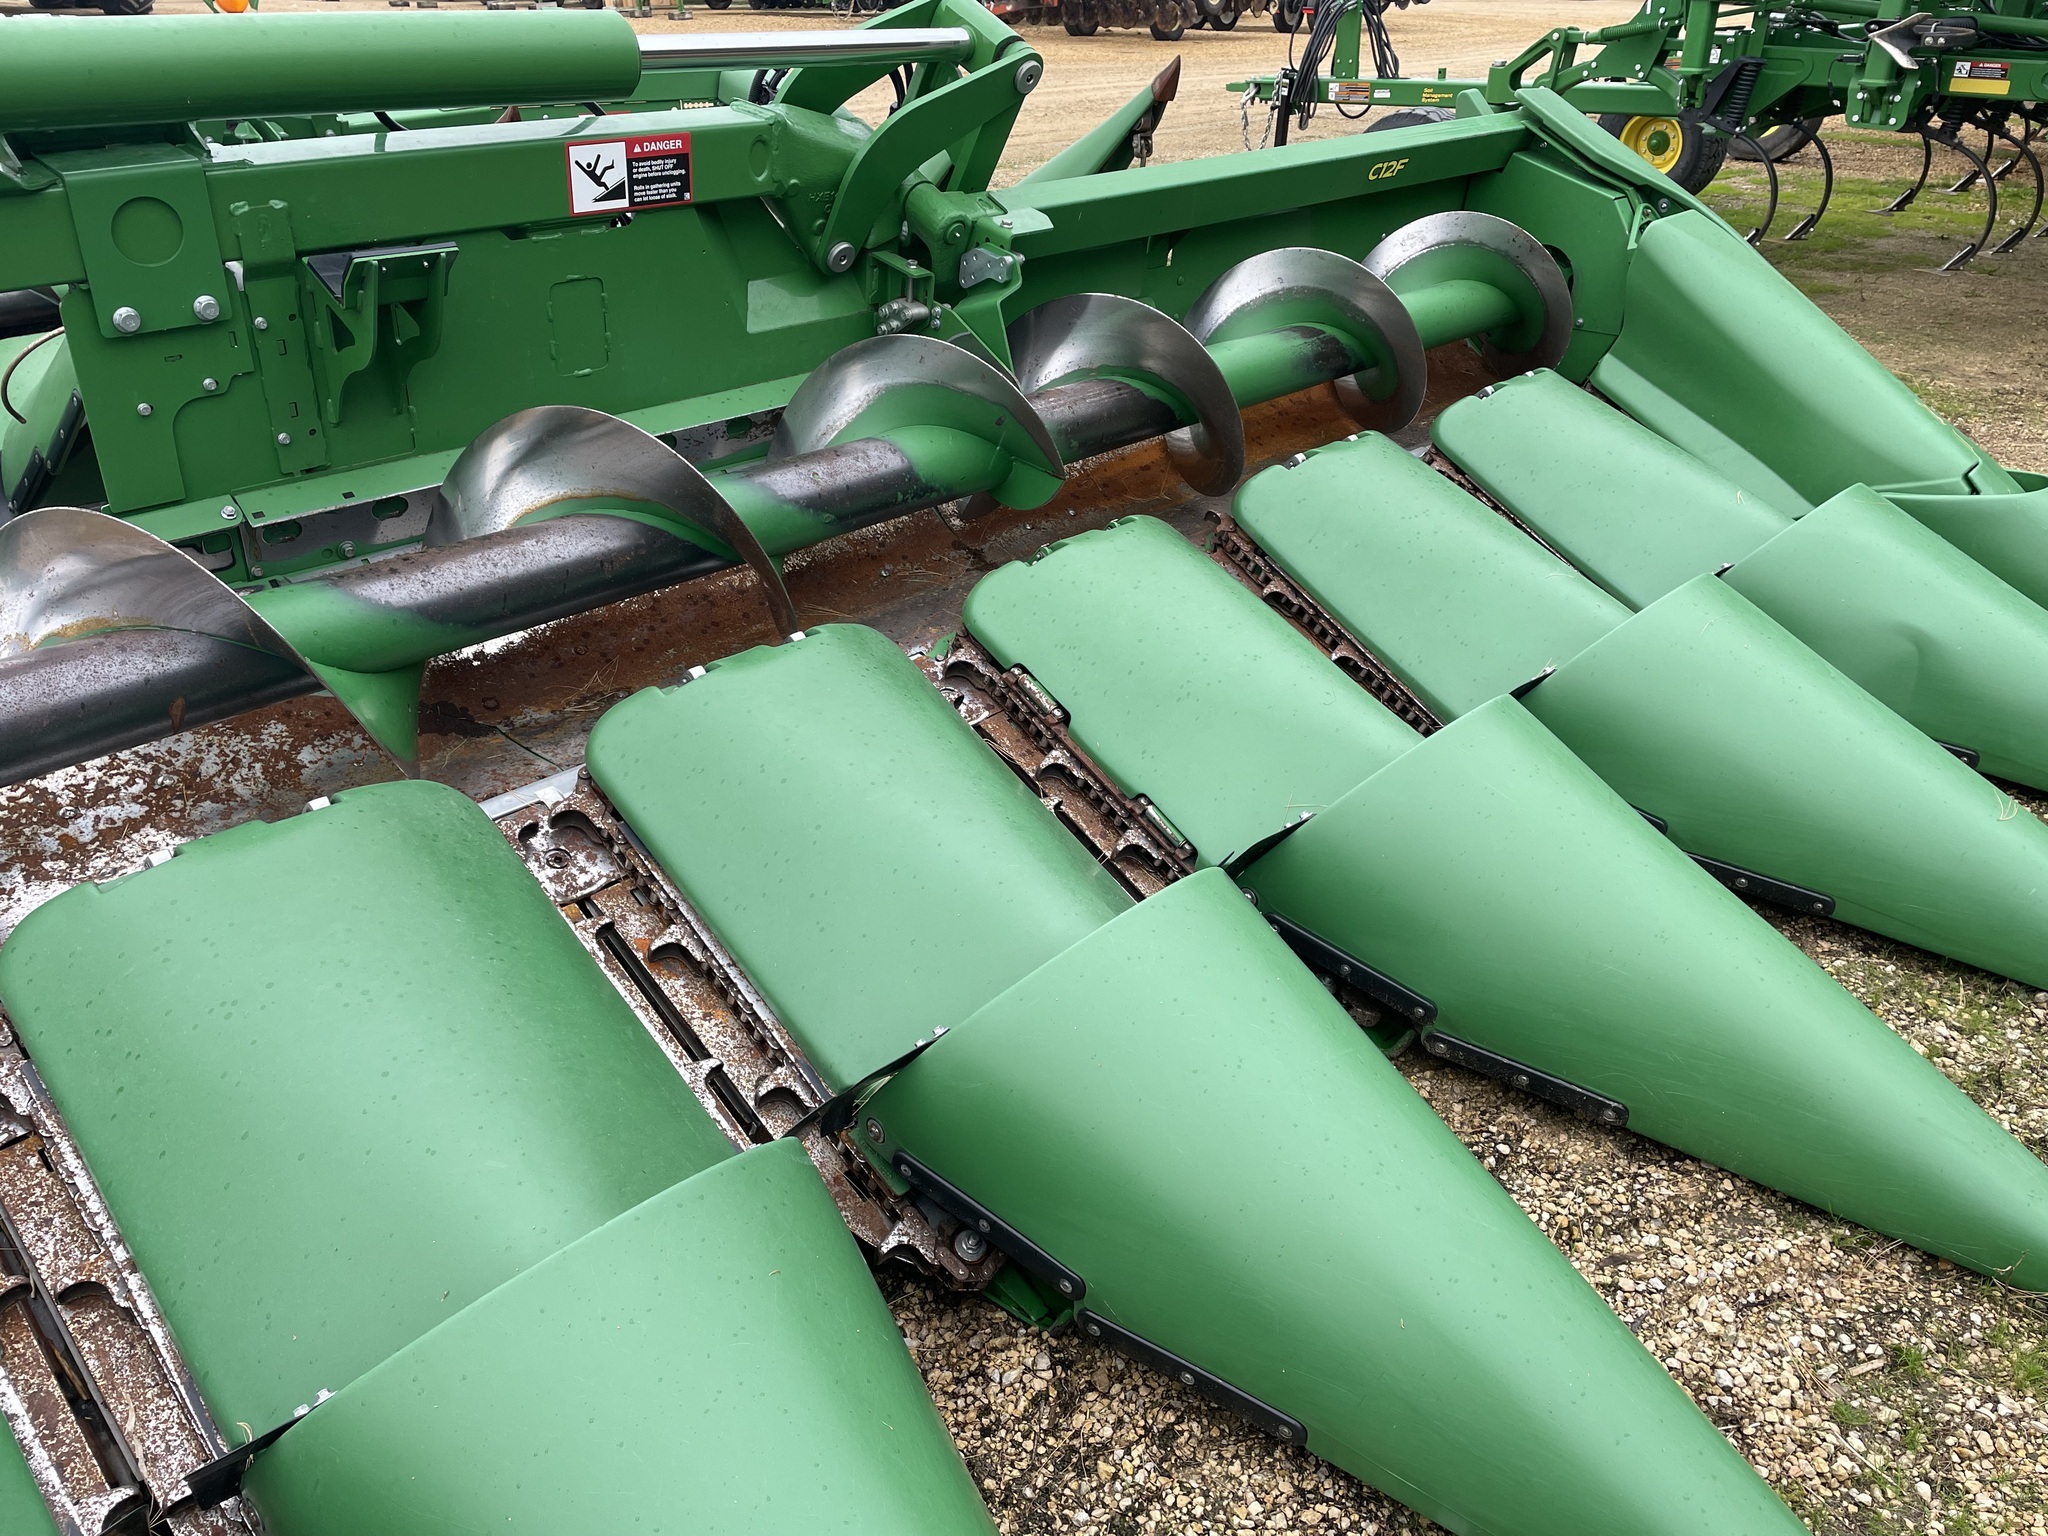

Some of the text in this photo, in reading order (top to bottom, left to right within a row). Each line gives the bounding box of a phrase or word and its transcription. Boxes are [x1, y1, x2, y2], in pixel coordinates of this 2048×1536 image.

[643, 139, 682, 152] DANGER
[1368, 158, 1410, 181] C12F
[650, 182, 670, 190] gathering
